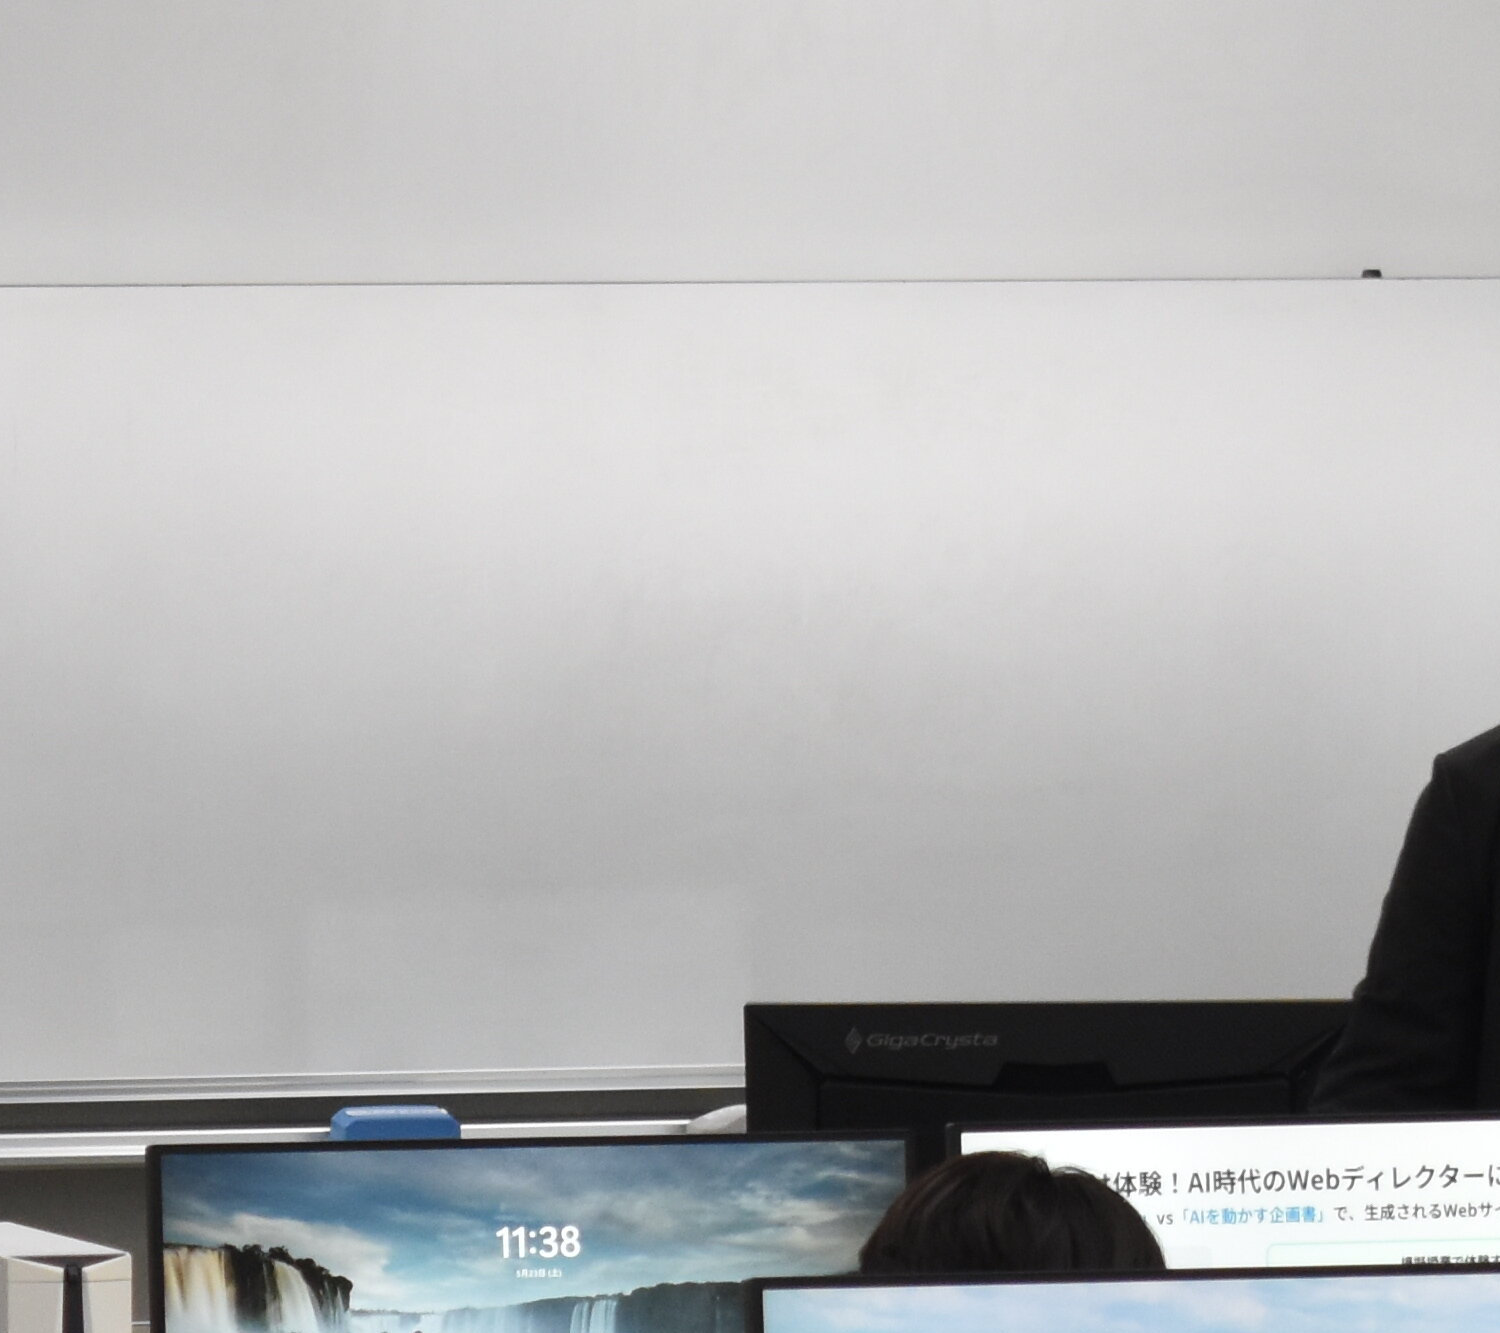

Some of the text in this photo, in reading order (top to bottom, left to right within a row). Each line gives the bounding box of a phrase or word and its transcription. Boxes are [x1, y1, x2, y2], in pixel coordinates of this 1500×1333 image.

[866, 1032, 998, 1049] GigaCrysta
[1157, 1211, 1174, 1225] vs
[495, 1225, 582, 1259] 11:38
